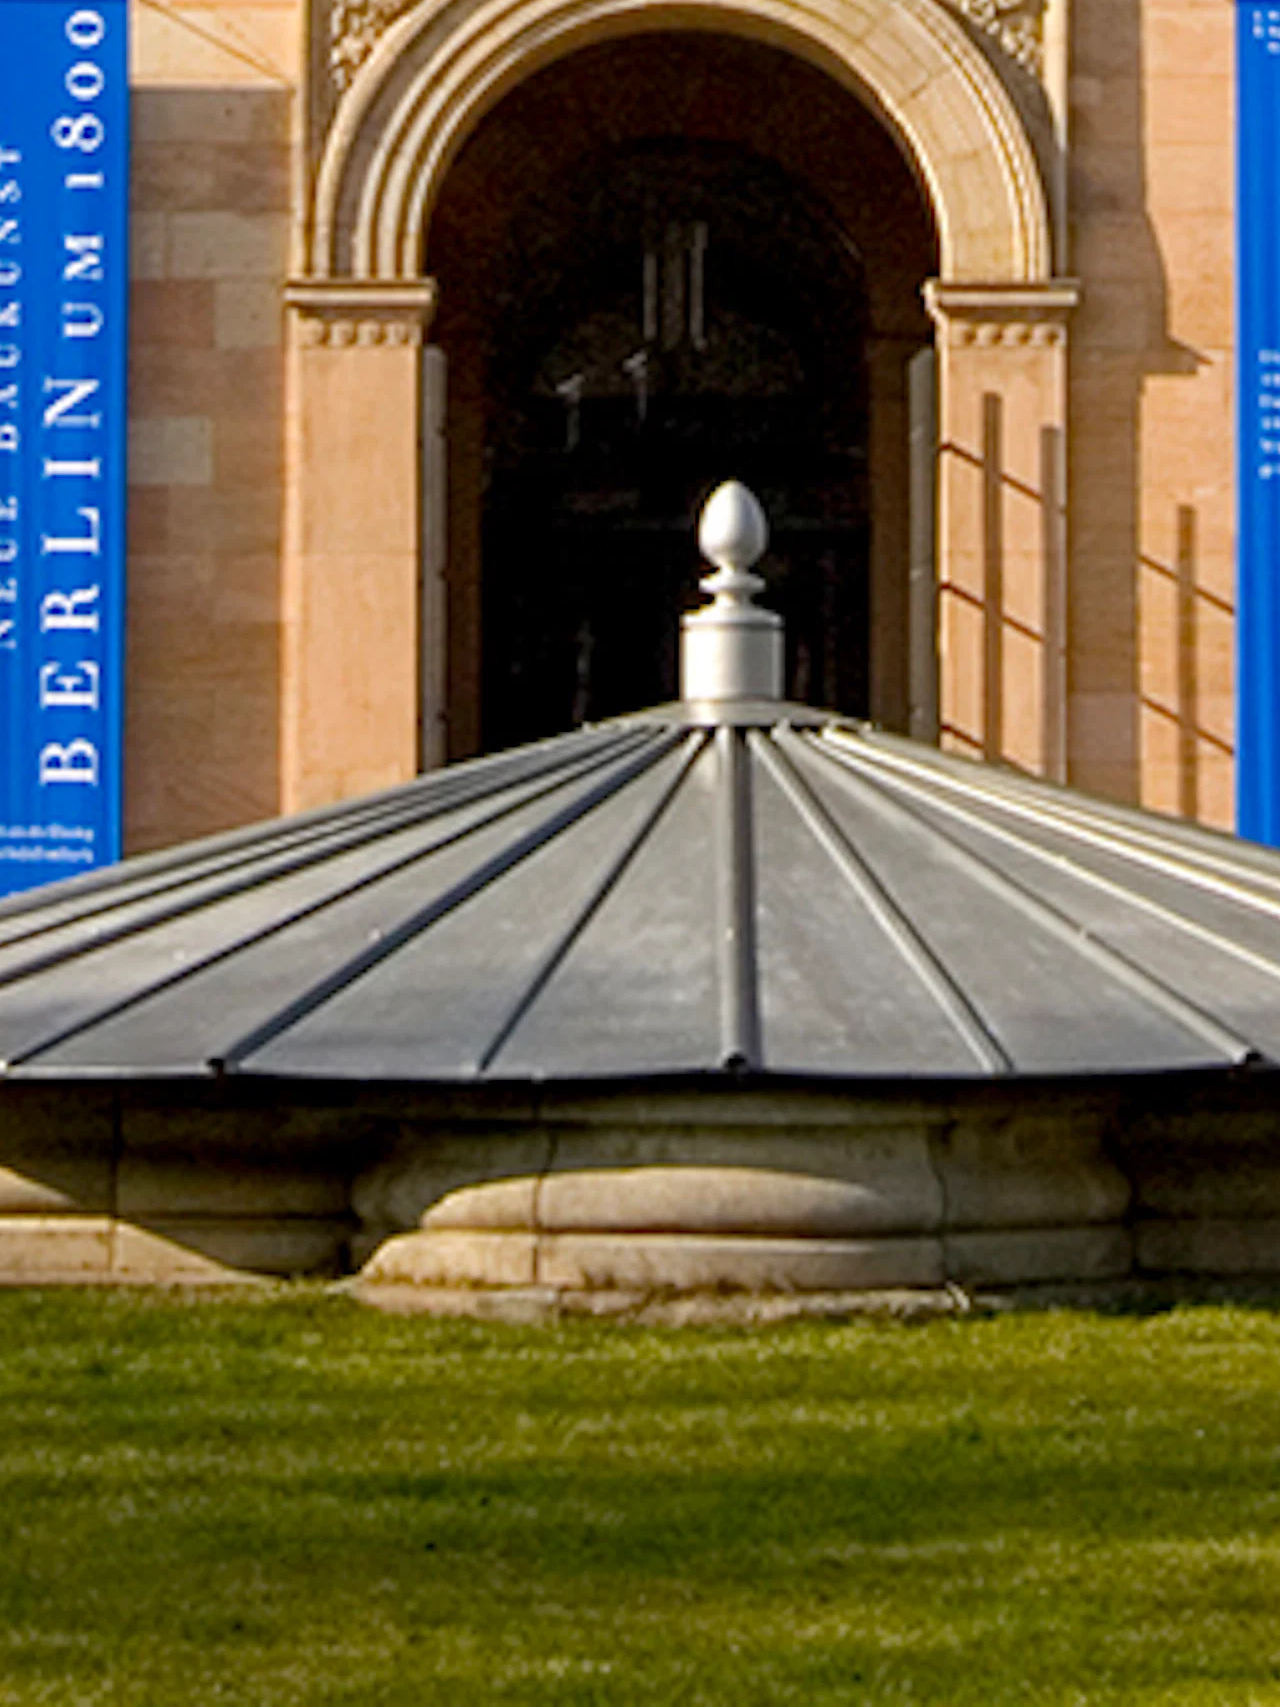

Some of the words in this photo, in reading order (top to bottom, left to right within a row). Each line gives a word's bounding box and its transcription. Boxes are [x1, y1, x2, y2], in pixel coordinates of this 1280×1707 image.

[50, 8, 106, 189] 1800
[62, 233, 104, 339] UM
[39, 376, 101, 786] BERLIN
